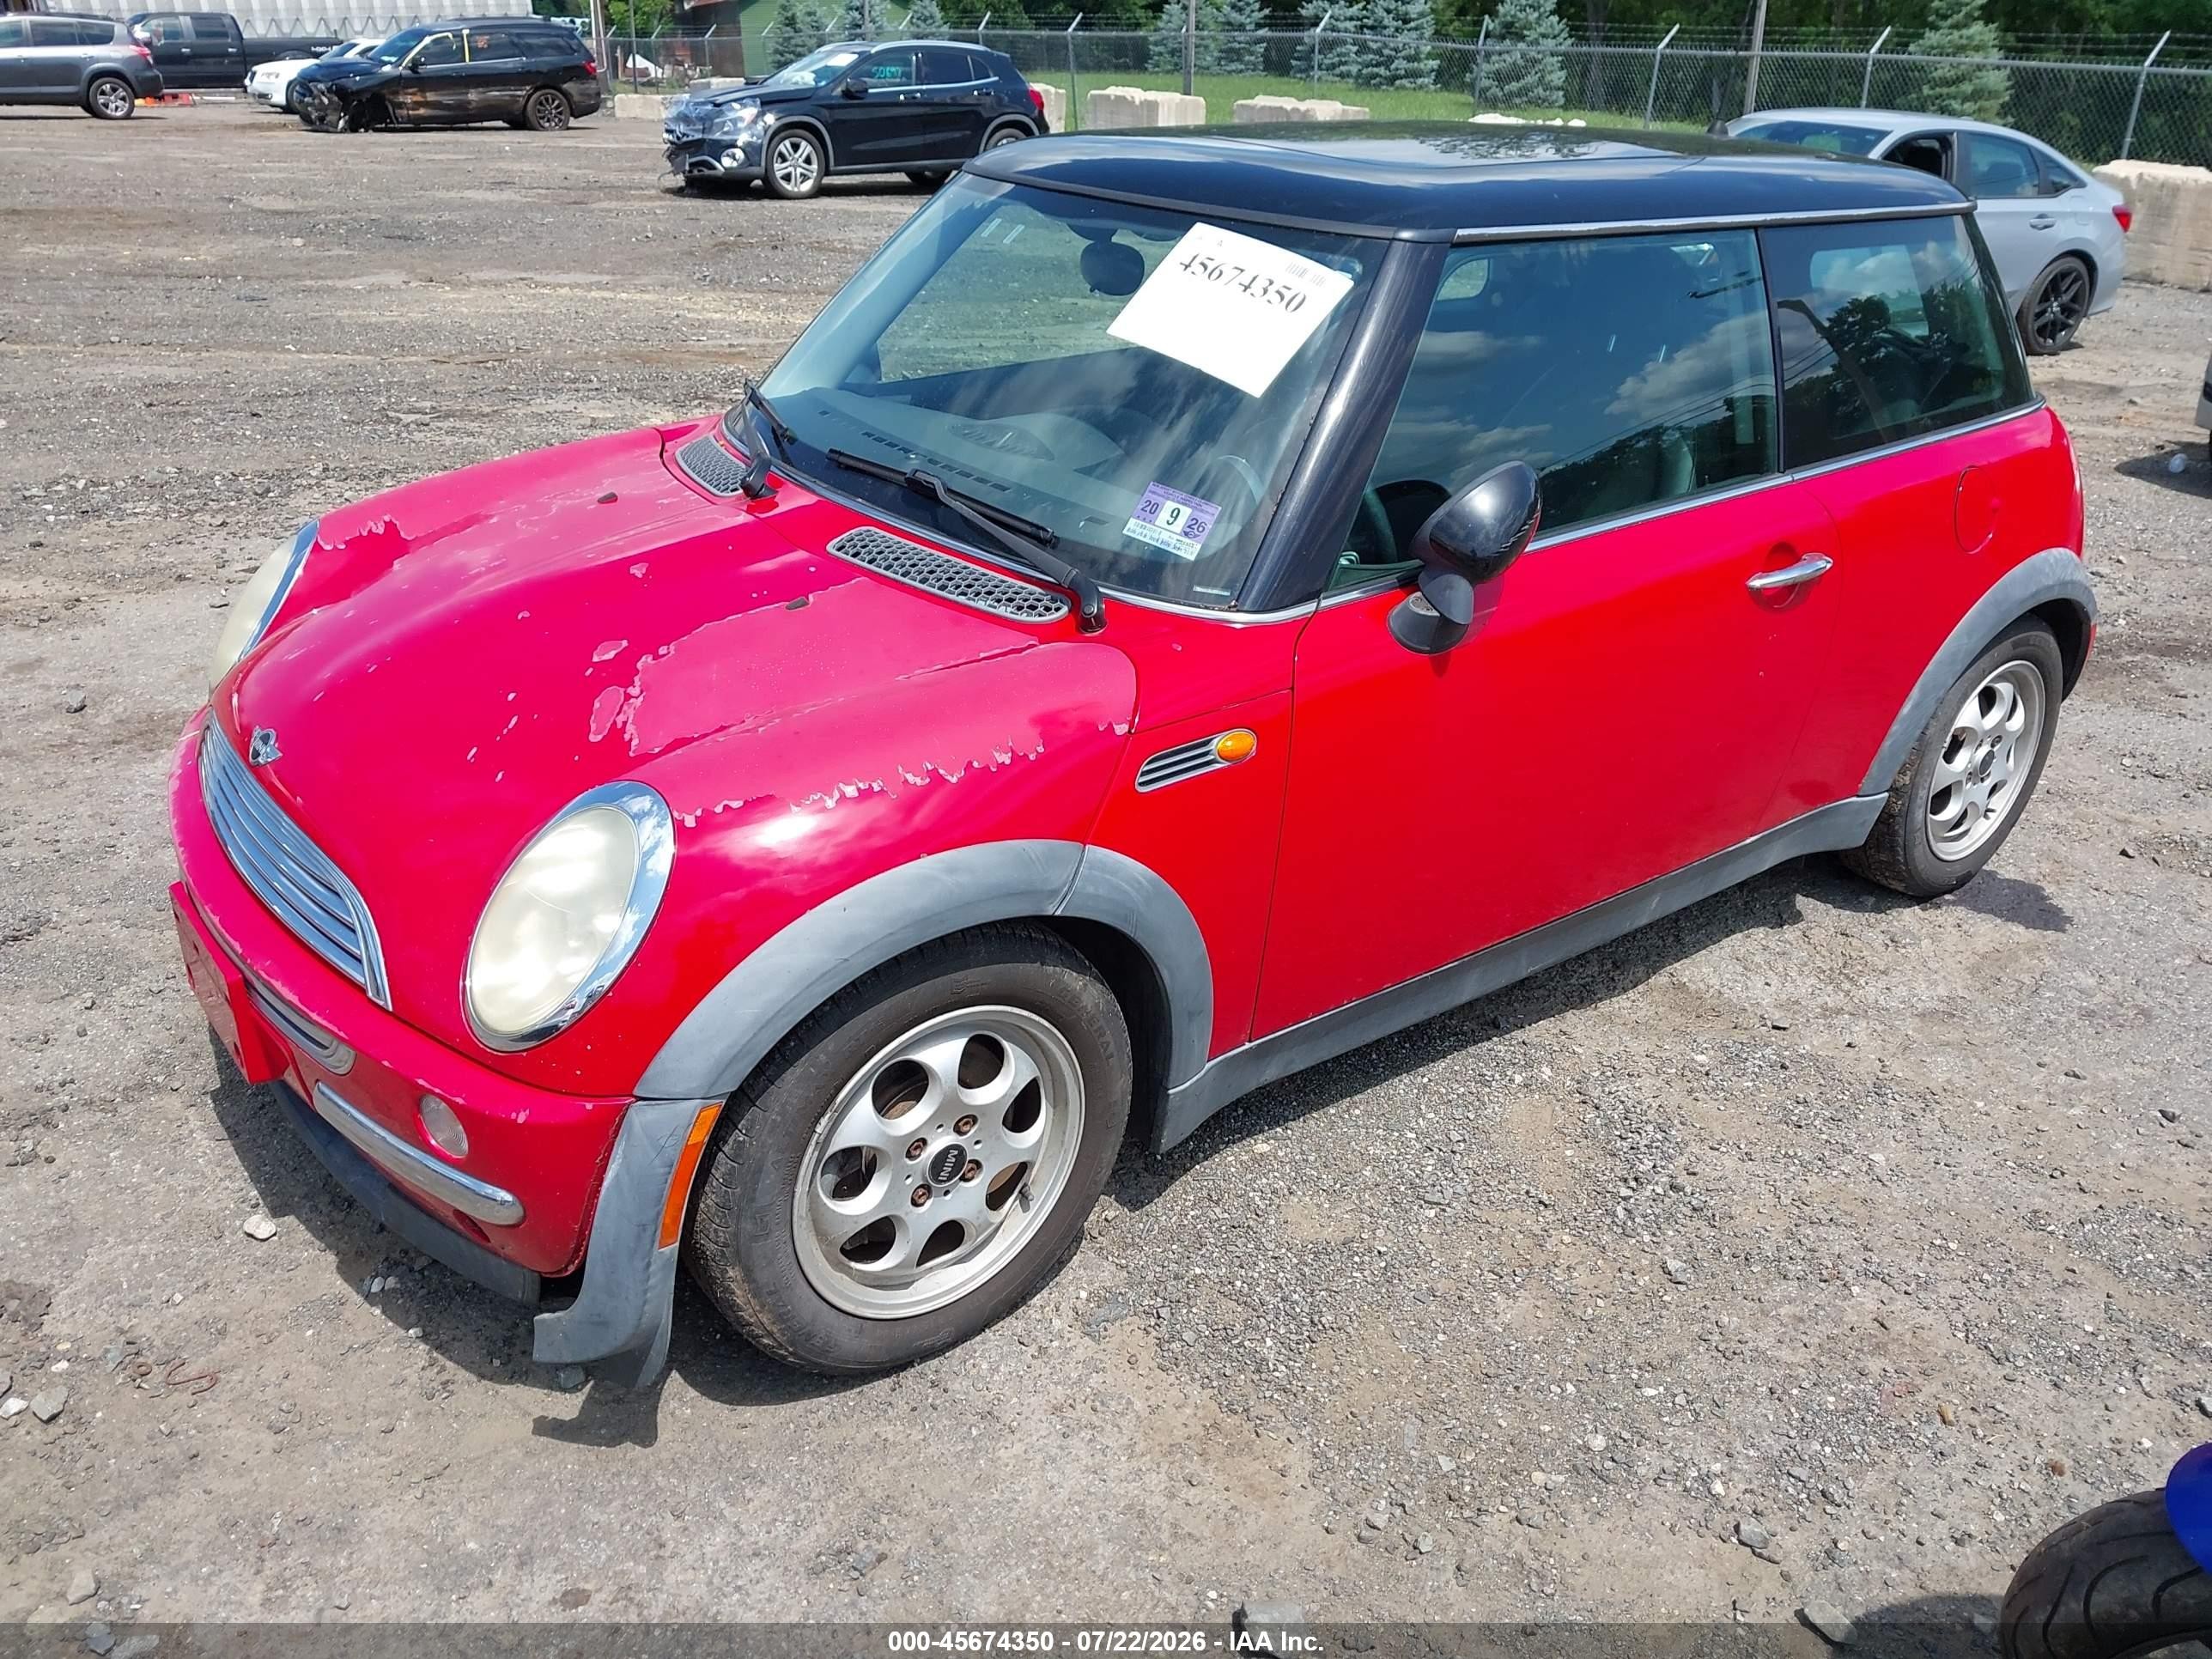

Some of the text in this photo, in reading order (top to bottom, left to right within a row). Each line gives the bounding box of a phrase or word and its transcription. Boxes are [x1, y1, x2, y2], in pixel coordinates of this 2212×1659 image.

[1179, 252, 1307, 313] 45674350
[1140, 499, 1160, 515] 20
[1166, 507, 1181, 526] 9
[1186, 517, 1208, 534] 26
[938, 1149, 959, 1181] MINI
